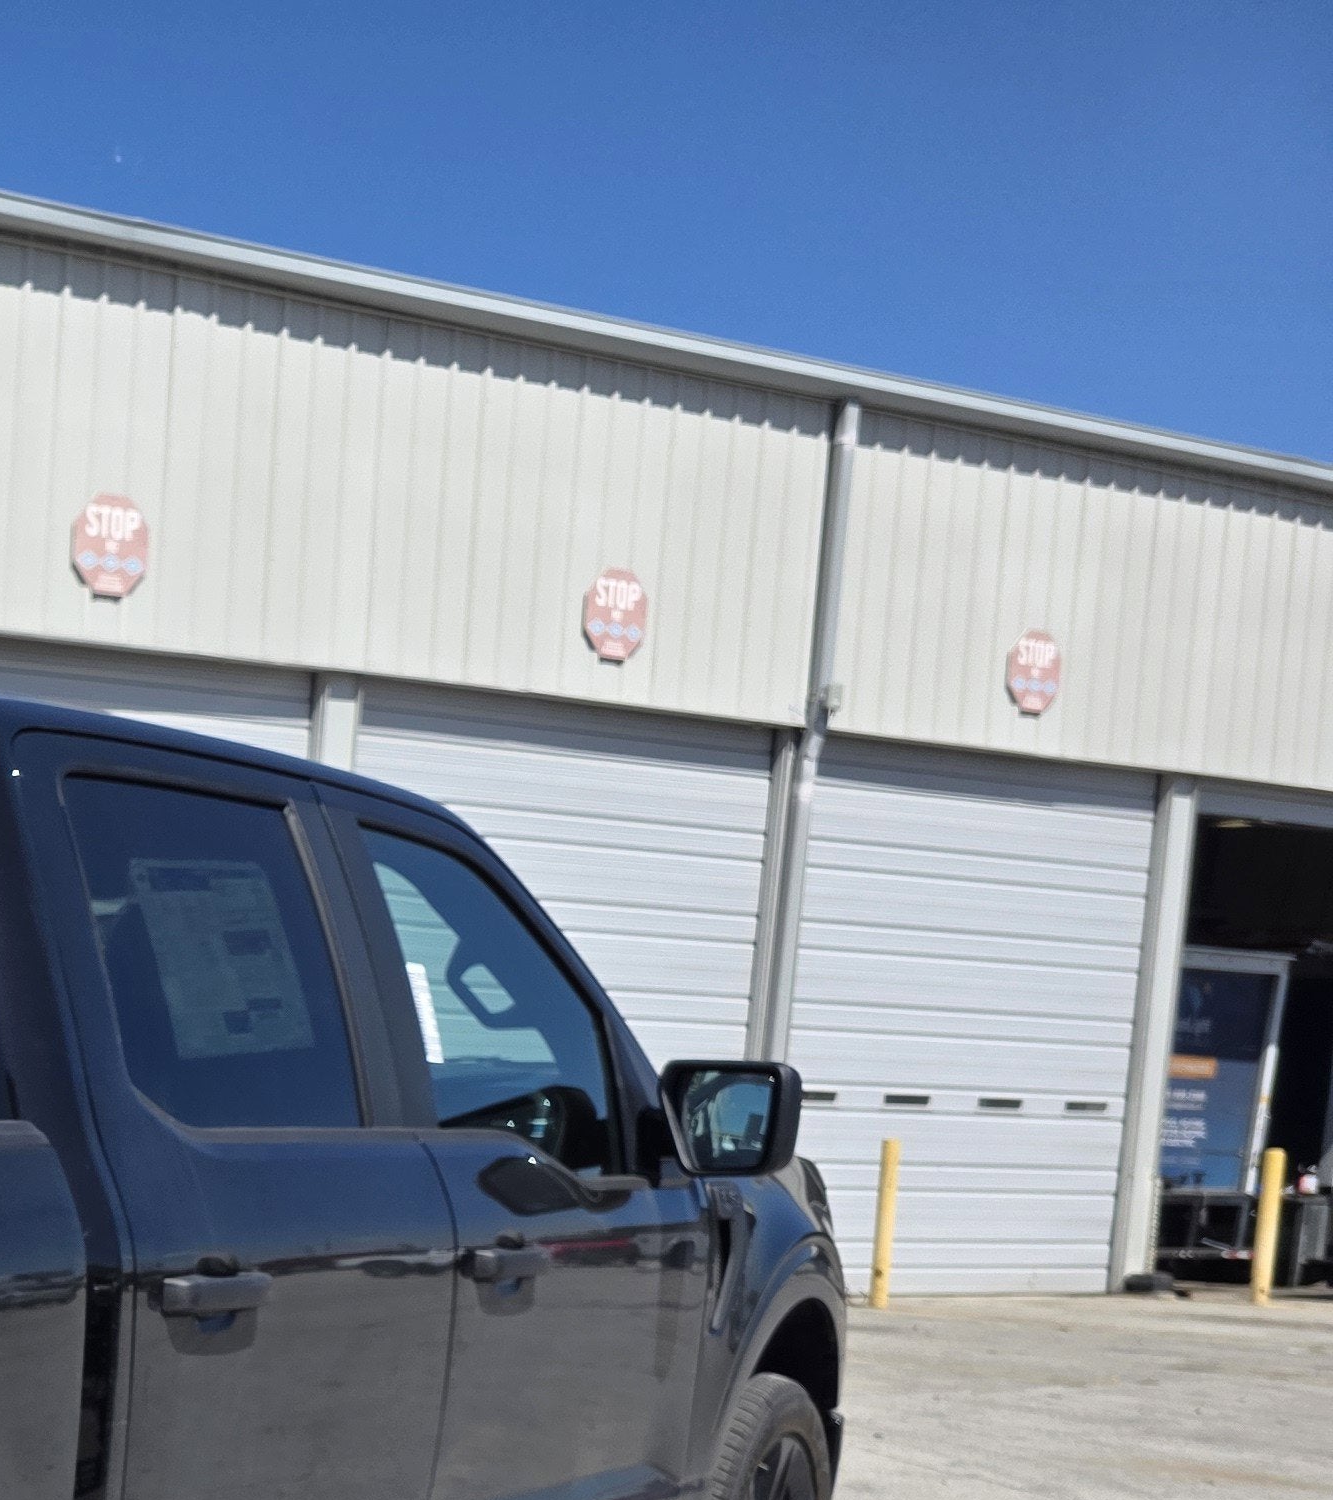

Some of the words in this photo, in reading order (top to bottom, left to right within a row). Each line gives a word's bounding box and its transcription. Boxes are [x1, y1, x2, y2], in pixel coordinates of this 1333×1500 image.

[85, 504, 141, 540] STOP
[595, 577, 642, 611] STOP
[1018, 638, 1060, 668] STOP
